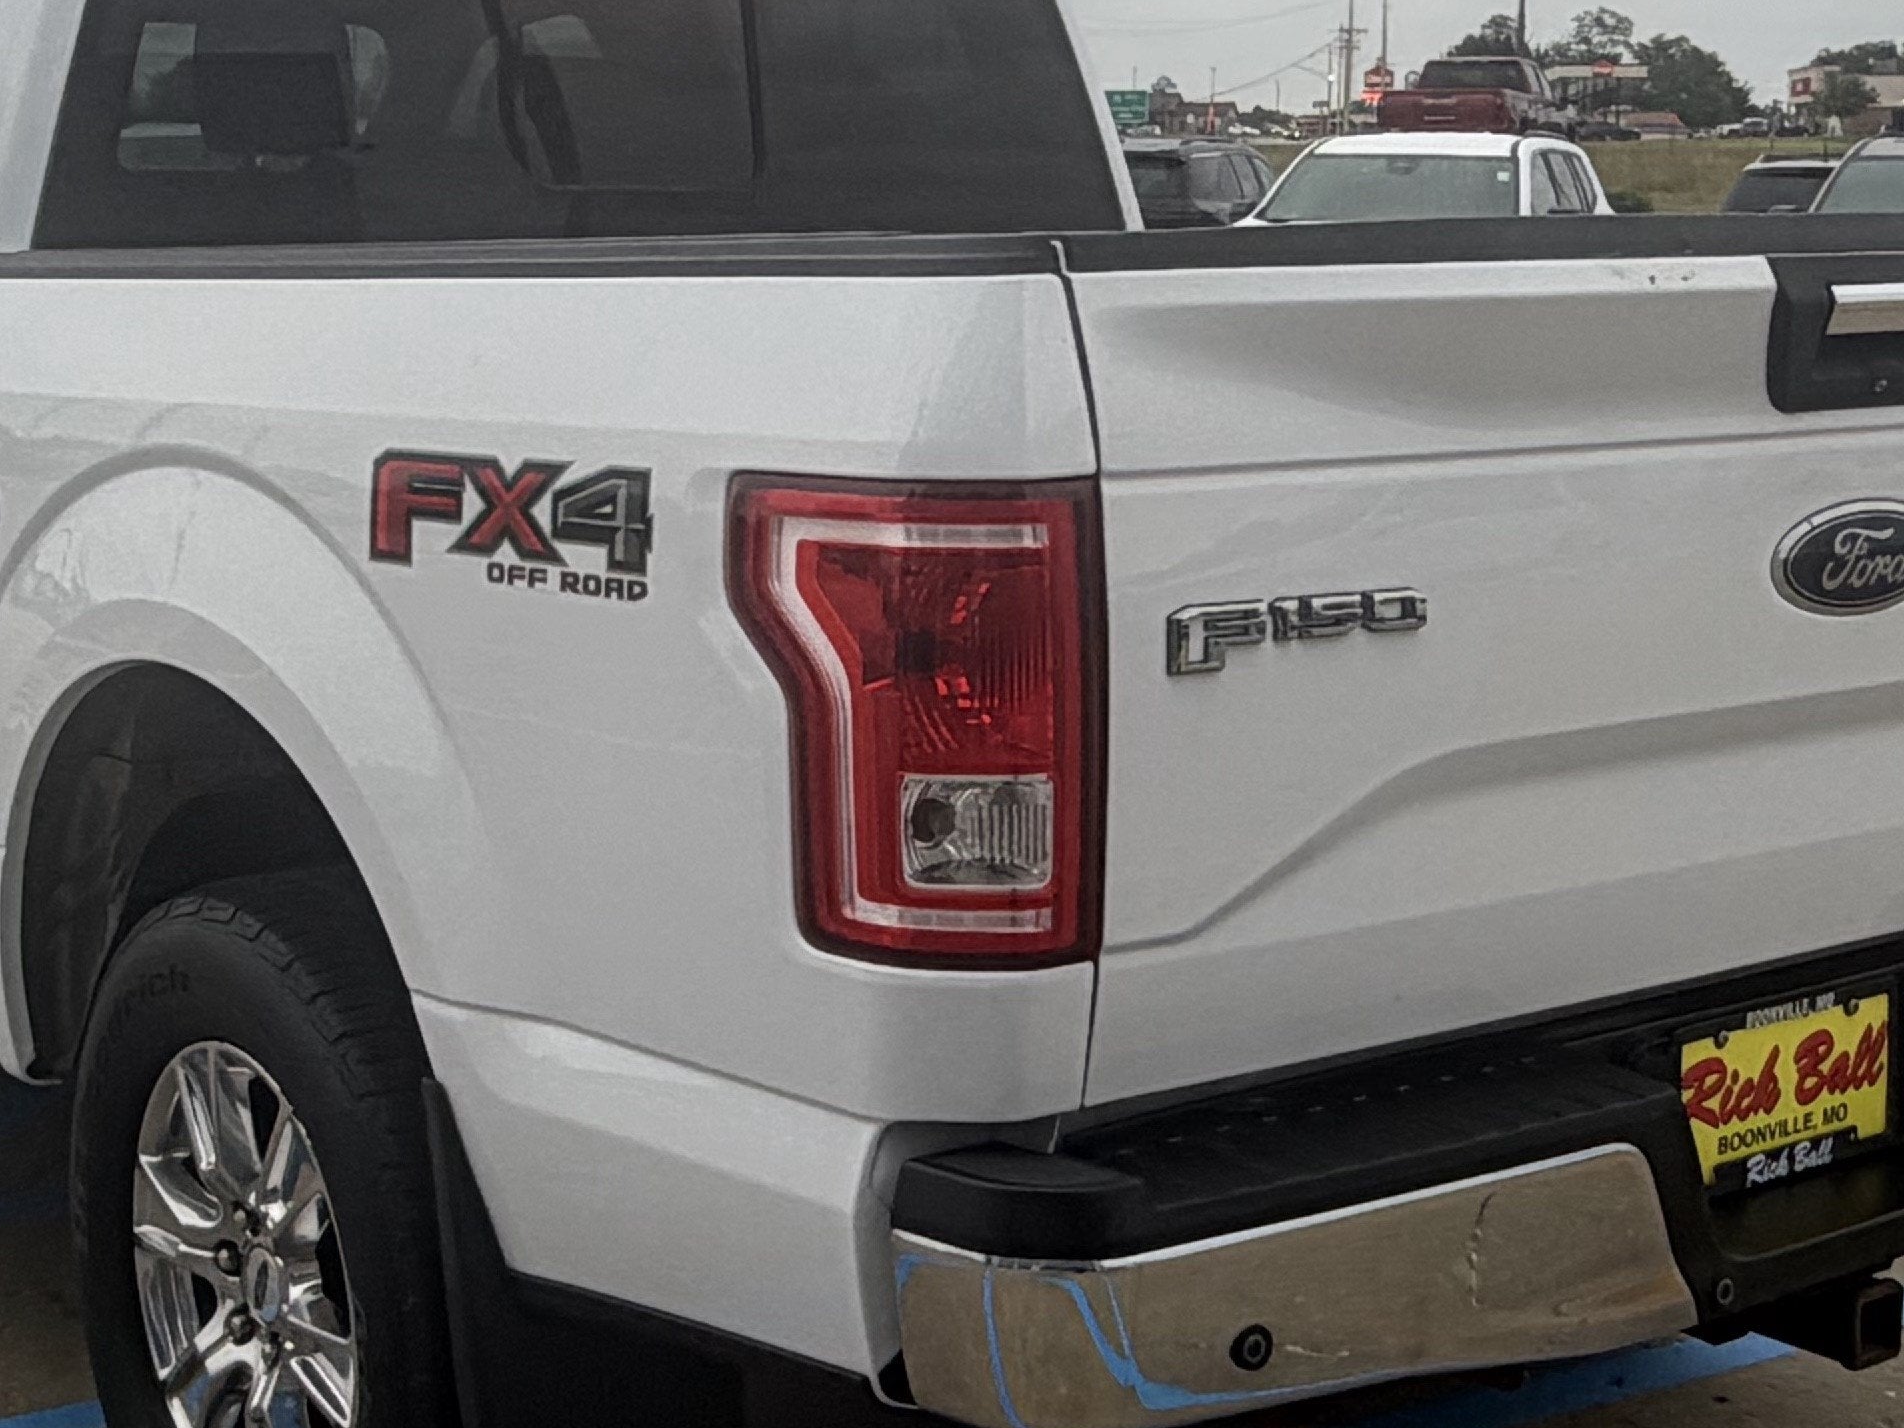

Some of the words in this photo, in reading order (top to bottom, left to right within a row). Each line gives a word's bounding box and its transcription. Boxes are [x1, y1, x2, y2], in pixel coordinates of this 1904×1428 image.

[369, 447, 654, 577] FX4
[486, 562, 548, 589] OFF
[559, 570, 649, 602] ROAD
[1681, 1044, 1781, 1130] Rick
[1793, 1020, 1888, 1106] Ball
[1717, 1116, 1817, 1155] BOONVILLE,
[1821, 1102, 1848, 1128] MO
[1746, 1146, 1788, 1187] Rick
[1795, 1137, 1834, 1172] Ball
